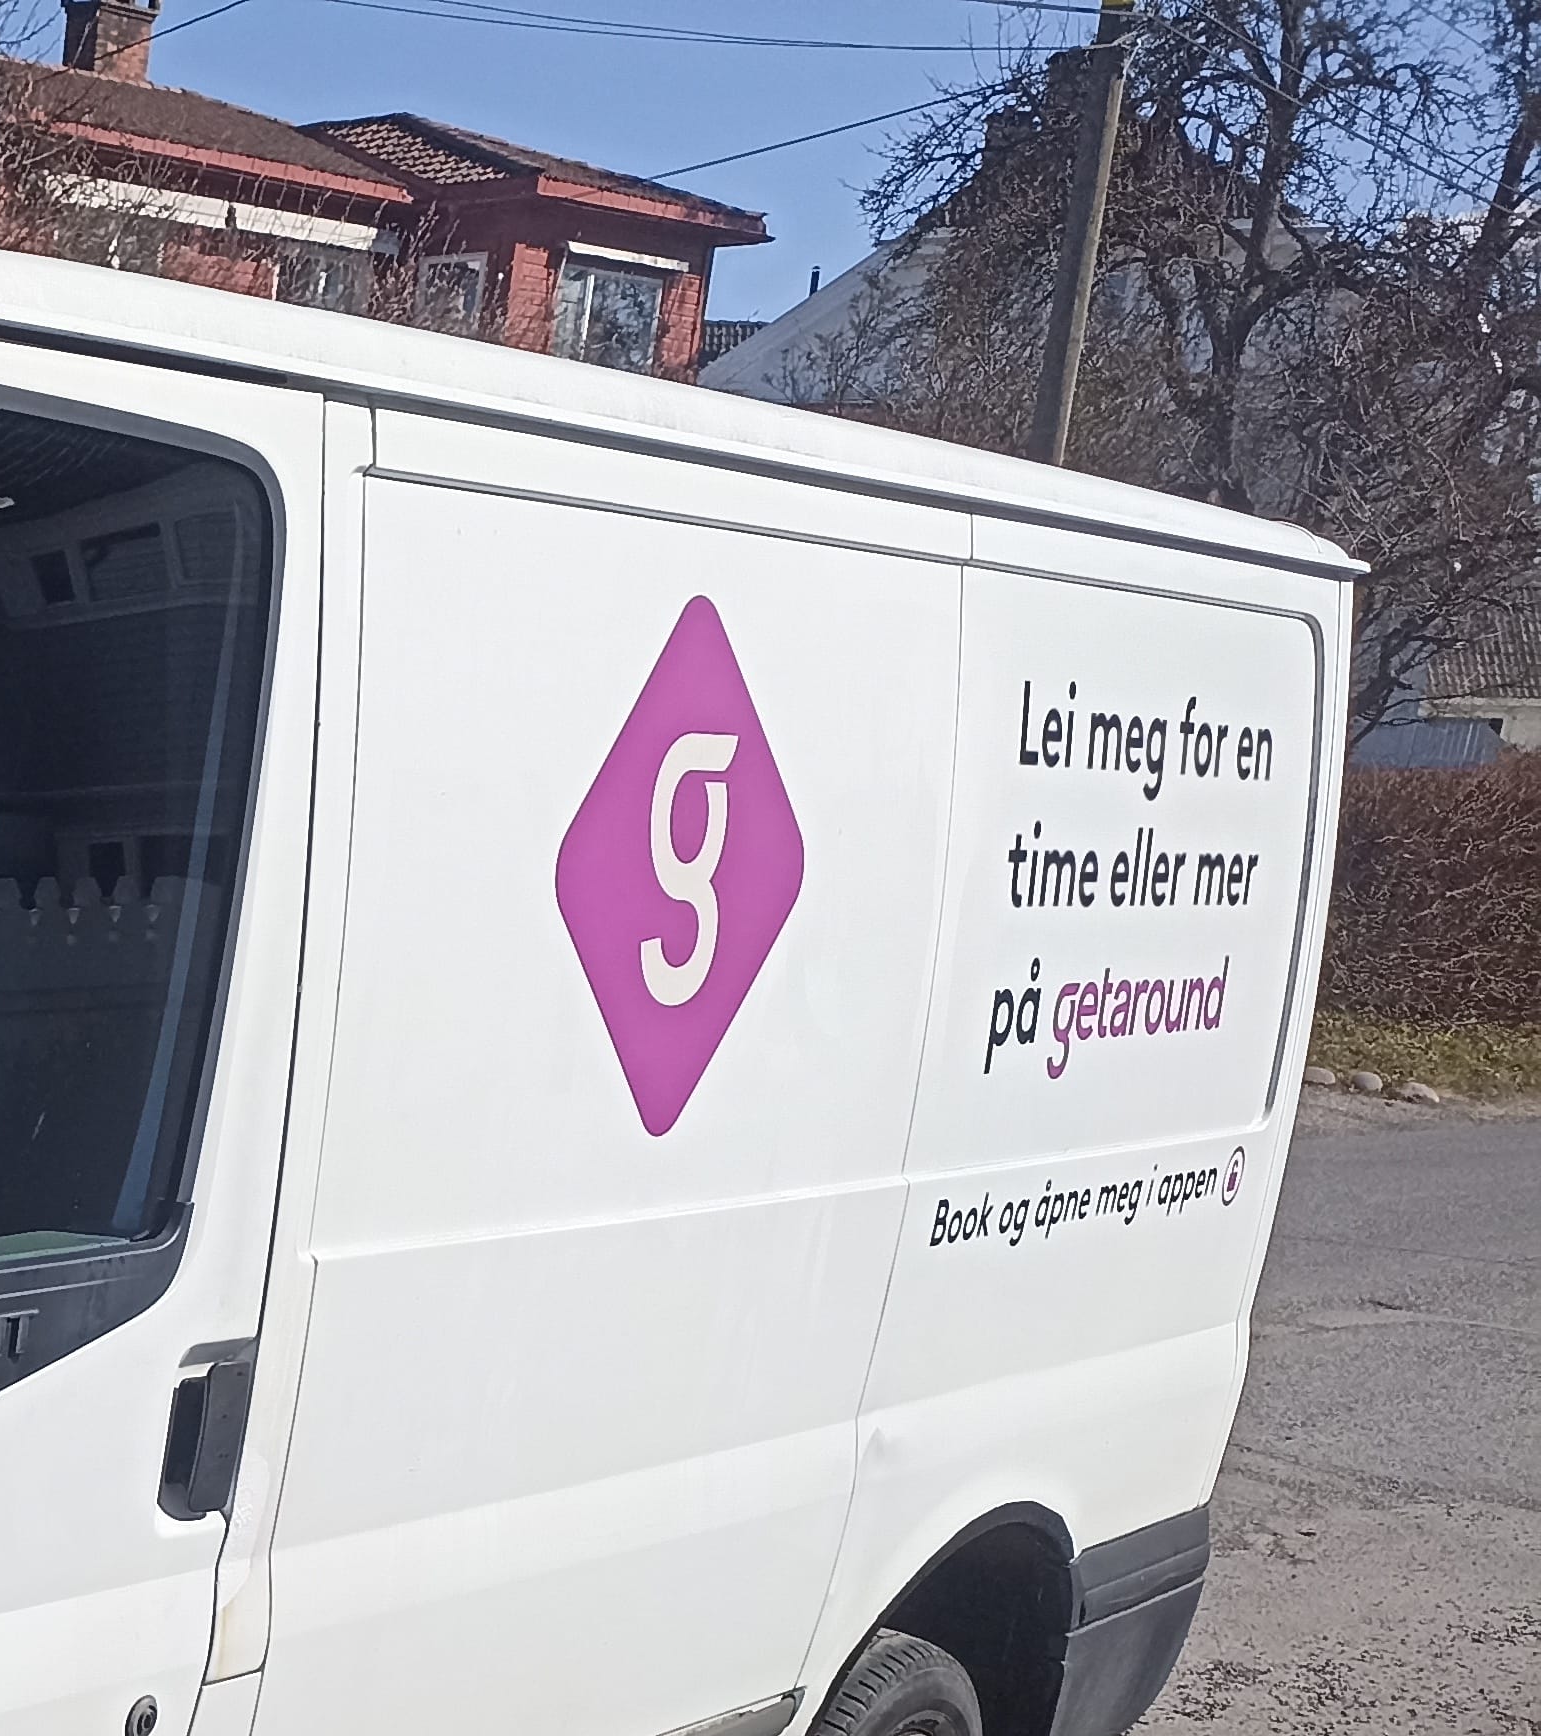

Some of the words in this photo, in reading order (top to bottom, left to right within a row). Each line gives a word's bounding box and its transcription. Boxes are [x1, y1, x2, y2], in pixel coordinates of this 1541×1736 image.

[1019, 680, 1077, 768] Lei
[1087, 712, 1167, 801] meg
[1179, 696, 1228, 778] for
[1236, 726, 1273, 781] en
[639, 730, 739, 1007] g
[1007, 820, 1099, 908] time
[1109, 827, 1186, 907] eller
[1193, 853, 1259, 907] mer
[983, 957, 1041, 1075] på
[1046, 955, 1229, 1080] getaround
[929, 1192, 994, 1247] Book
[998, 1198, 1030, 1247] og
[1034, 1179, 1091, 1239] åpne
[1095, 1178, 1143, 1226] meg
[1145, 1164, 1158, 1206] i
[1157, 1166, 1218, 1216] appen
